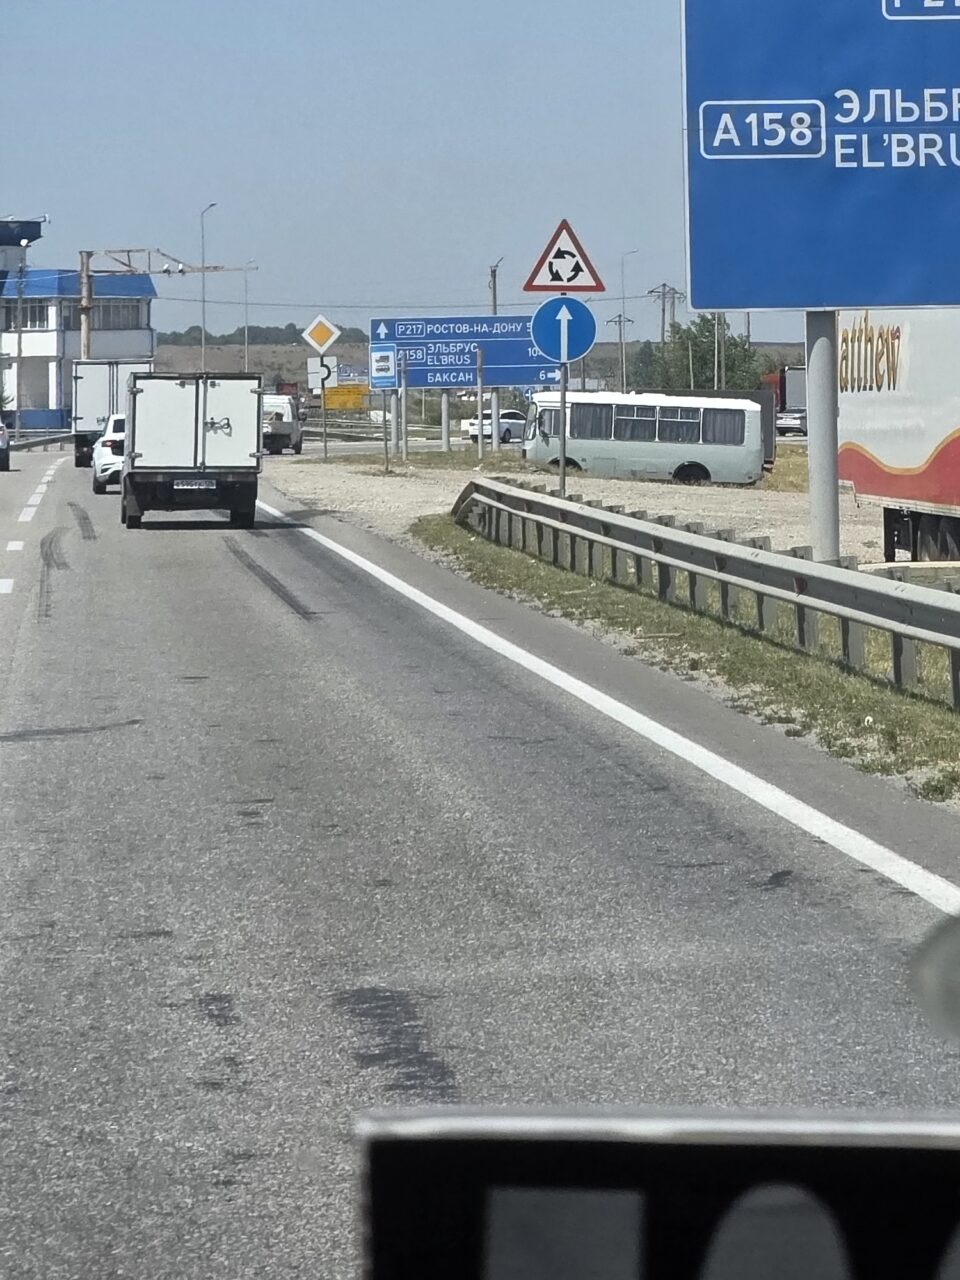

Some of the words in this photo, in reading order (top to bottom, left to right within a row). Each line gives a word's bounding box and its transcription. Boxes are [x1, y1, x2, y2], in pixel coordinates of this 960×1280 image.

[711, 111, 812, 147] А158
[398, 325, 422, 335] Р217
[426, 322, 522, 334] РОСТОВ-НА-ДОНУ
[427, 343, 478, 354] ЭЛЬБРУС
[839, 308, 901, 394] atthew
[427, 371, 473, 383] БАКСАН
[539, 370, 546, 381] 6
